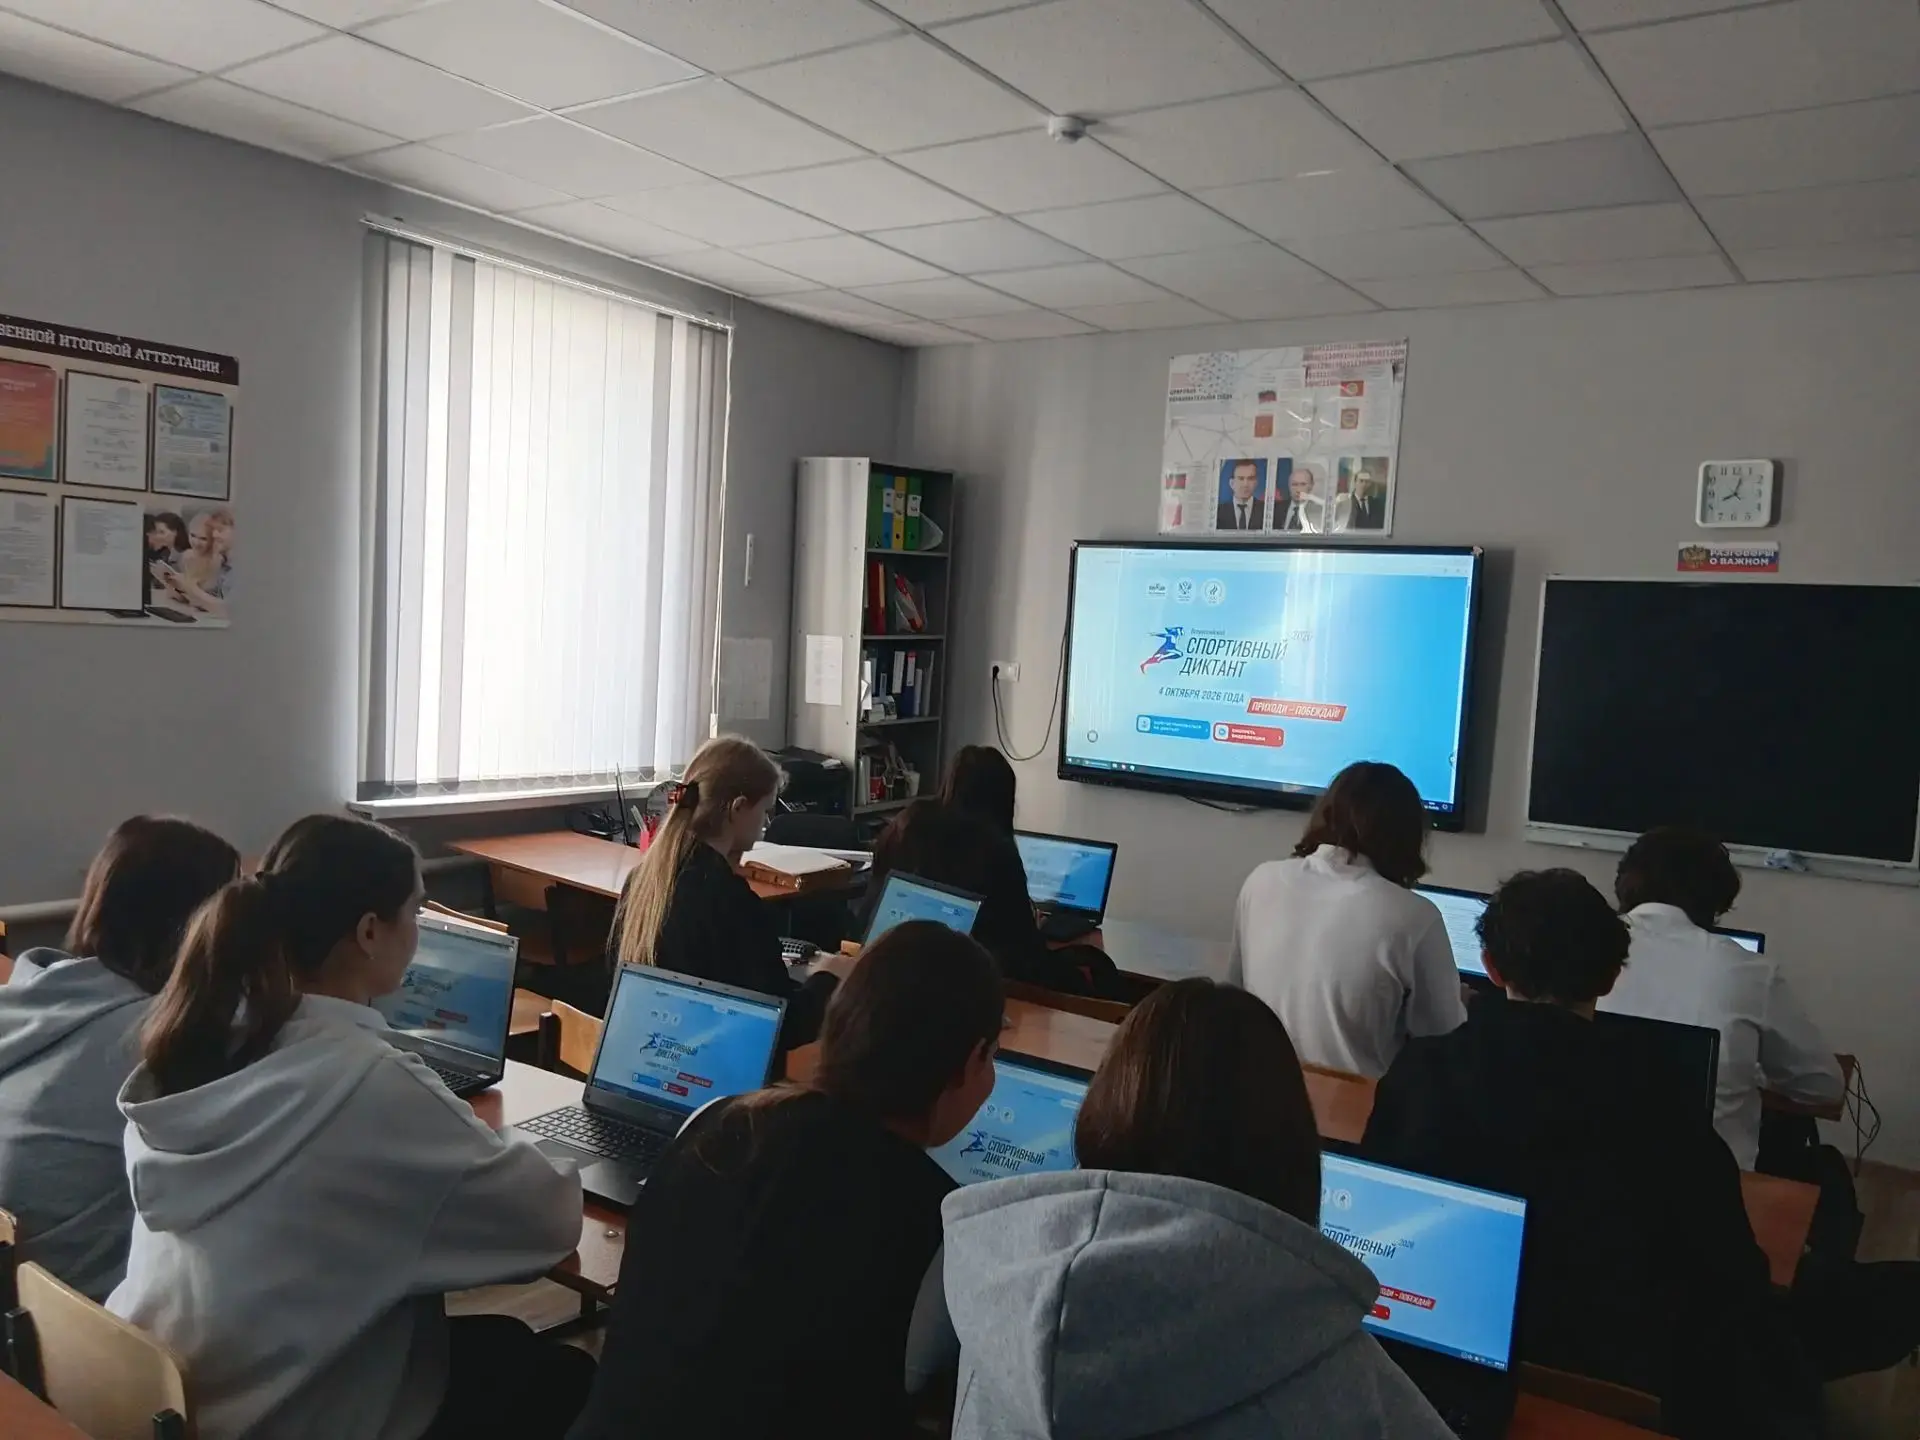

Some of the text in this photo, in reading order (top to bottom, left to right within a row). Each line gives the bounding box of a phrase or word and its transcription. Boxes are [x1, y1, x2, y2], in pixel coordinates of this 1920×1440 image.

[59, 333, 132, 359] ИТОГОВОЙ
[135, 347, 221, 374] АТТЕСТАЦИИ
[1710, 549, 1775, 558] РАЗГОВОРЫ
[1720, 557, 1769, 566] ВАЖНОМ
[1186, 637, 1288, 661] СПОРТИВНЫЙ
[1179, 657, 1248, 678] ДИКТАНТ
[1158, 687, 1245, 704] 4 ОКТЯБРЯ 2026 ГОДА
[1251, 701, 1288, 714] ПРИХОДИ
[1295, 704, 1340, 719] ПОБЕЖДАЙ!
[982, 1151, 1021, 1171] ДИКТАНТ
[987, 1139, 1045, 1166] СПОРТИВНЫЙ
